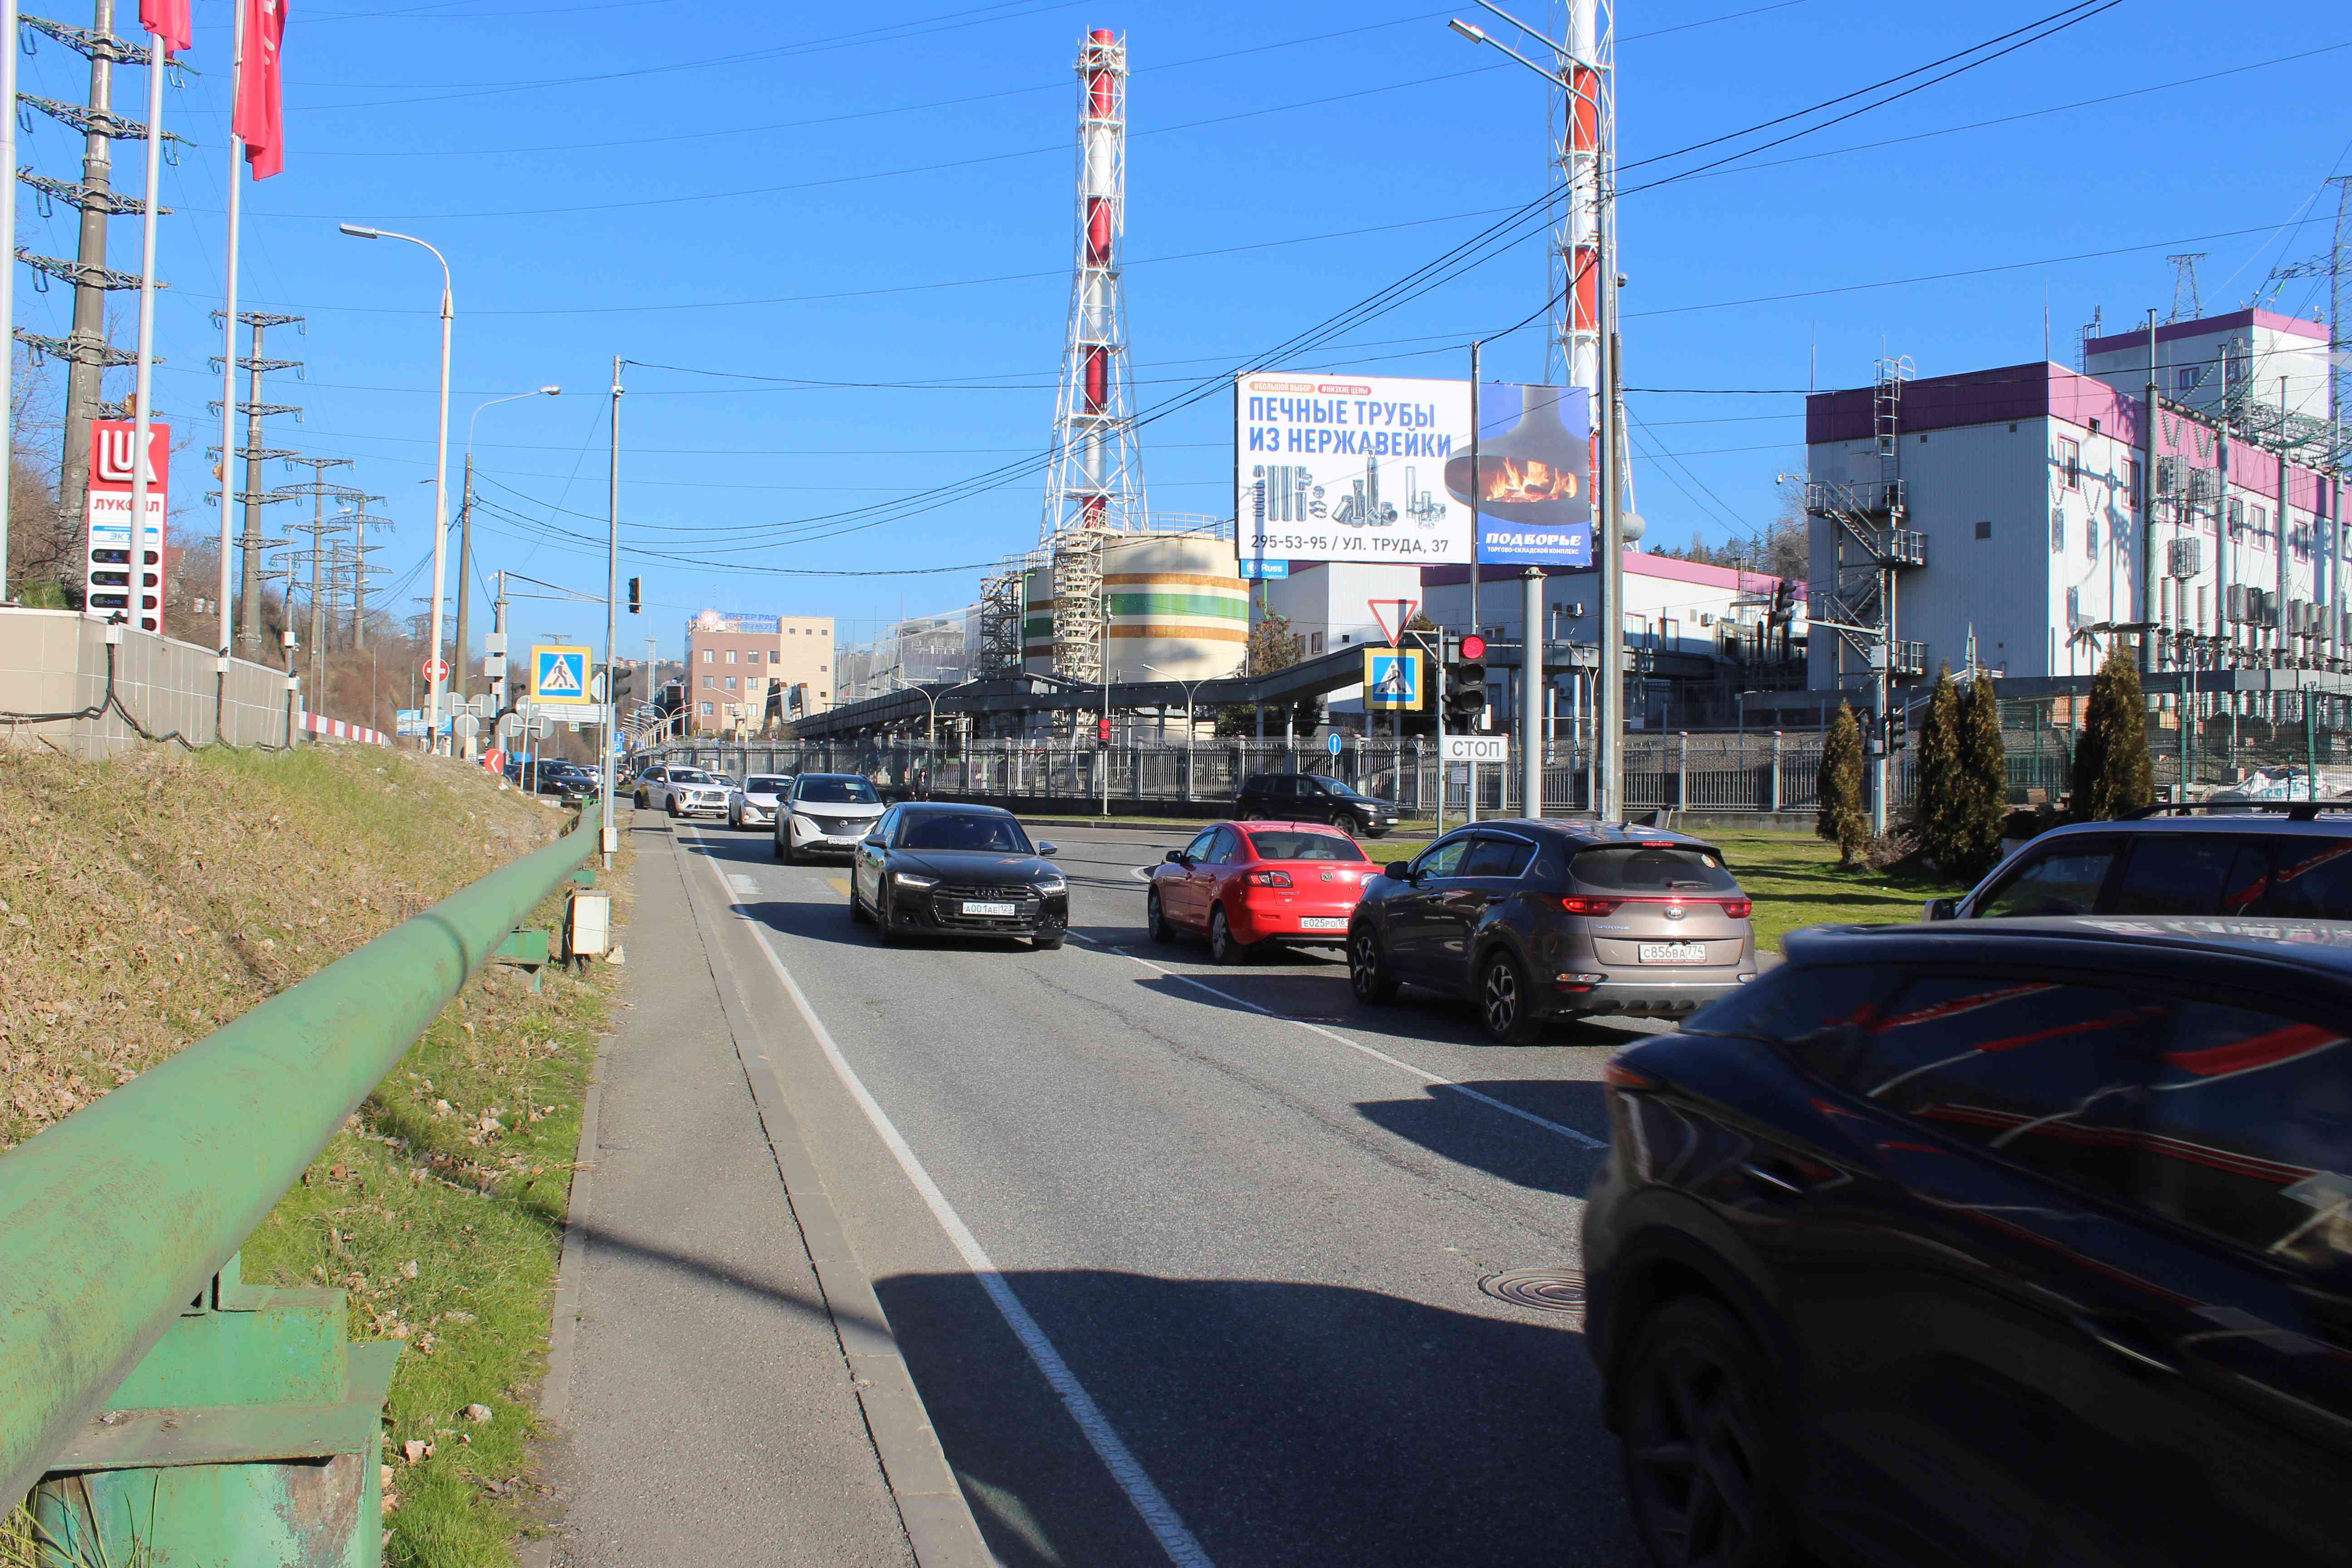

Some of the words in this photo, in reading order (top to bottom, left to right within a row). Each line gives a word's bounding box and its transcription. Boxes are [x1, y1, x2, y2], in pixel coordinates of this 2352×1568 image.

[1254, 382, 1289, 391] #БОЛЬШОЙ
[1351, 387, 1368, 395] ЦЕНЫ
[1250, 397, 1348, 424] ПЕЧНЫЕ
[1354, 401, 1435, 428] ТРУБЫ
[1250, 427, 1279, 451] ИЗ
[1288, 427, 1450, 458] НЕРЖАВЕЙКИ
[94, 498, 160, 512] ЛУКОЛ
[1251, 535, 1327, 550] 295-53-95
[1343, 537, 1367, 550] УЛ.
[1372, 538, 1426, 554] ТРУДА,
[1432, 540, 1448, 553] 37
[1485, 533, 1582, 547] ПОДВОРЬЕ
[1261, 564, 1283, 573] Russ
[1452, 740, 1499, 757] СТОП
[1304, 919, 1335, 927] Е025РО
[1644, 946, 1685, 958] С856ВА
[1687, 946, 1704, 955] 774
